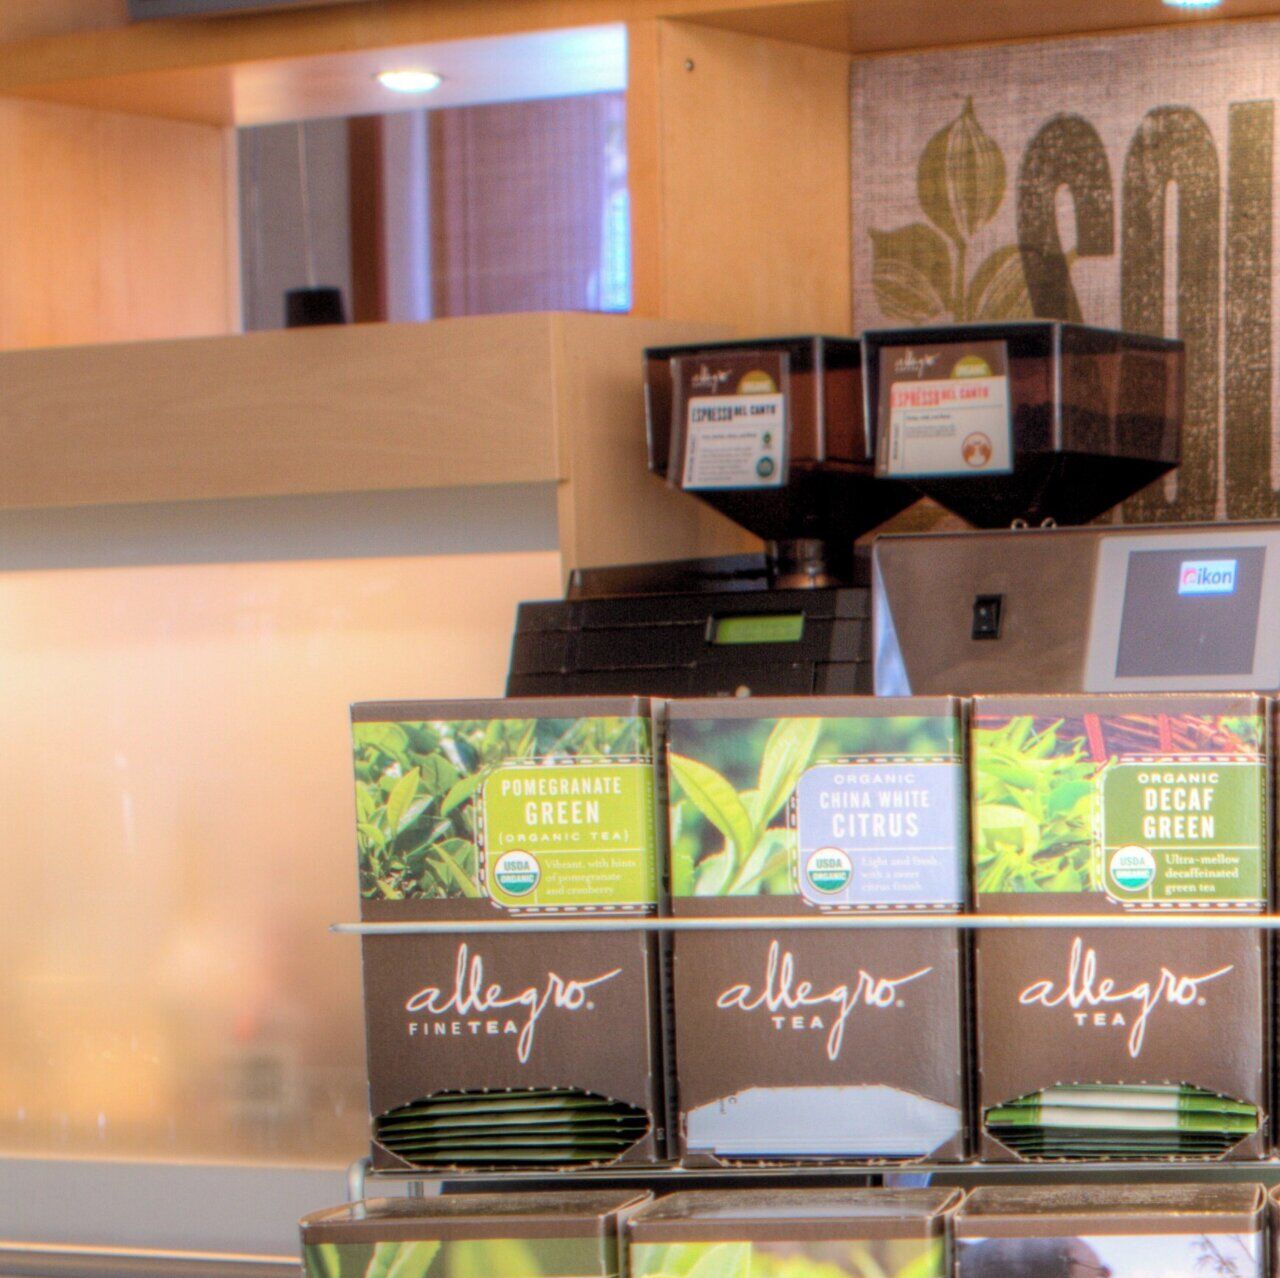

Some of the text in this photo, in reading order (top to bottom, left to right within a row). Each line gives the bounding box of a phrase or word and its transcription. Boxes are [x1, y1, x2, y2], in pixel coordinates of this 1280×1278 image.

[501, 776, 622, 798] POMEGRANATE
[833, 773, 916, 786] ORGANIC
[1138, 772, 1220, 785] ORGANIC
[818, 789, 931, 811] CHINA WHITE
[1144, 787, 1216, 812] DECAF
[524, 800, 600, 826] GREEN
[832, 811, 920, 839] CITRUS
[1143, 814, 1216, 840] GREEN
[1165, 866, 1240, 880] decaffeinated
[772, 1016, 825, 1031] TEA
[1073, 1012, 1127, 1027] TEA
